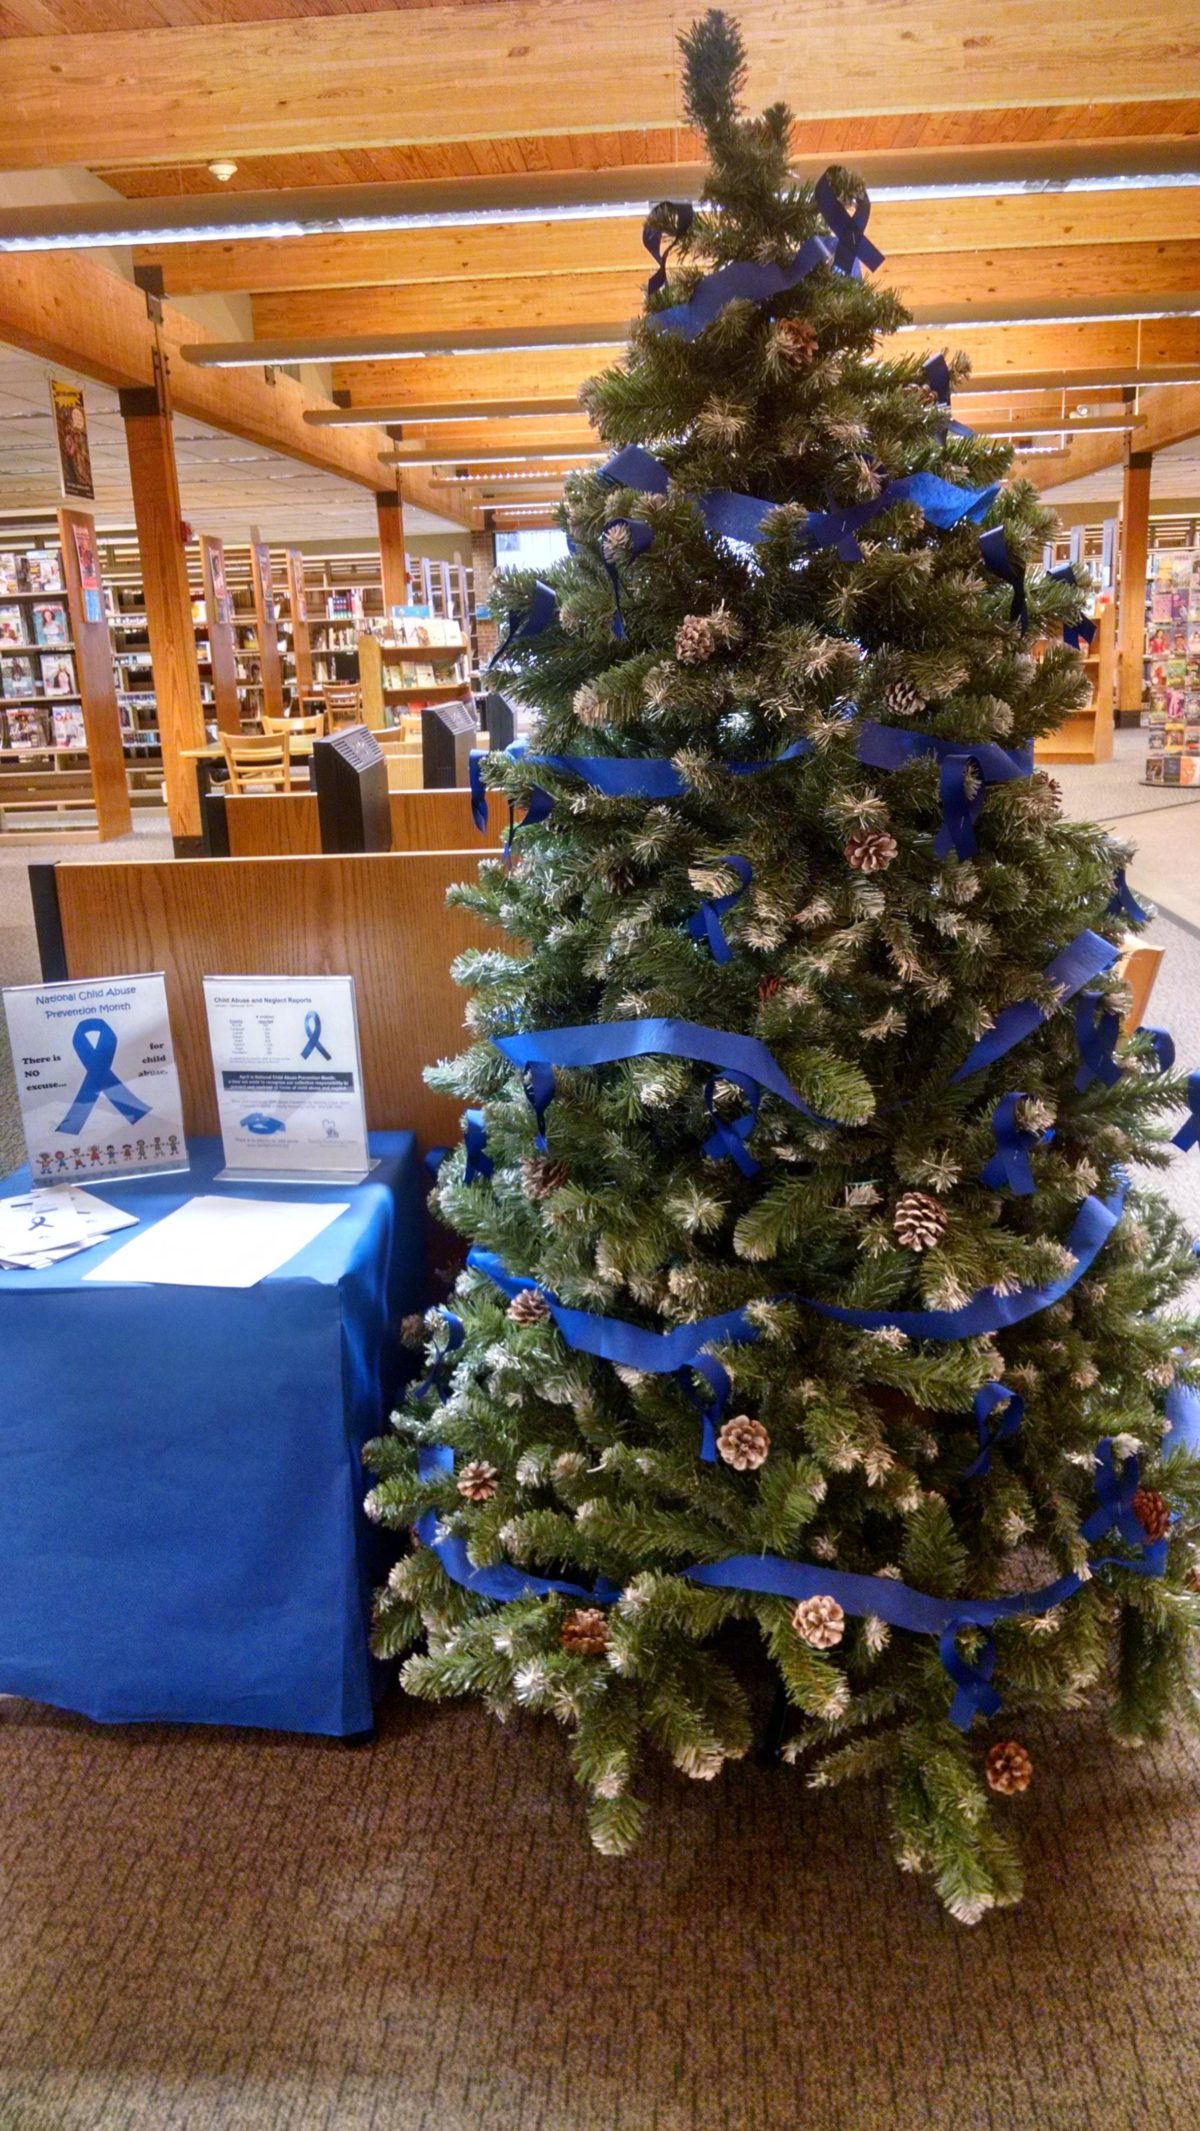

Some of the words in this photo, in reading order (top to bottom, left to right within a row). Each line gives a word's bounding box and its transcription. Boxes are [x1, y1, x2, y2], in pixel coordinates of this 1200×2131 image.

[36, 993, 76, 1005] National
[78, 989, 104, 1000] Child
[106, 986, 136, 996] Abuse
[46, 1007, 97, 1018] Prevention
[99, 1002, 130, 1013] Month
[149, 1042, 164, 1050] for
[22, 1057, 51, 1065] There
[142, 1054, 166, 1064] child
[24, 1070, 40, 1078] NO
